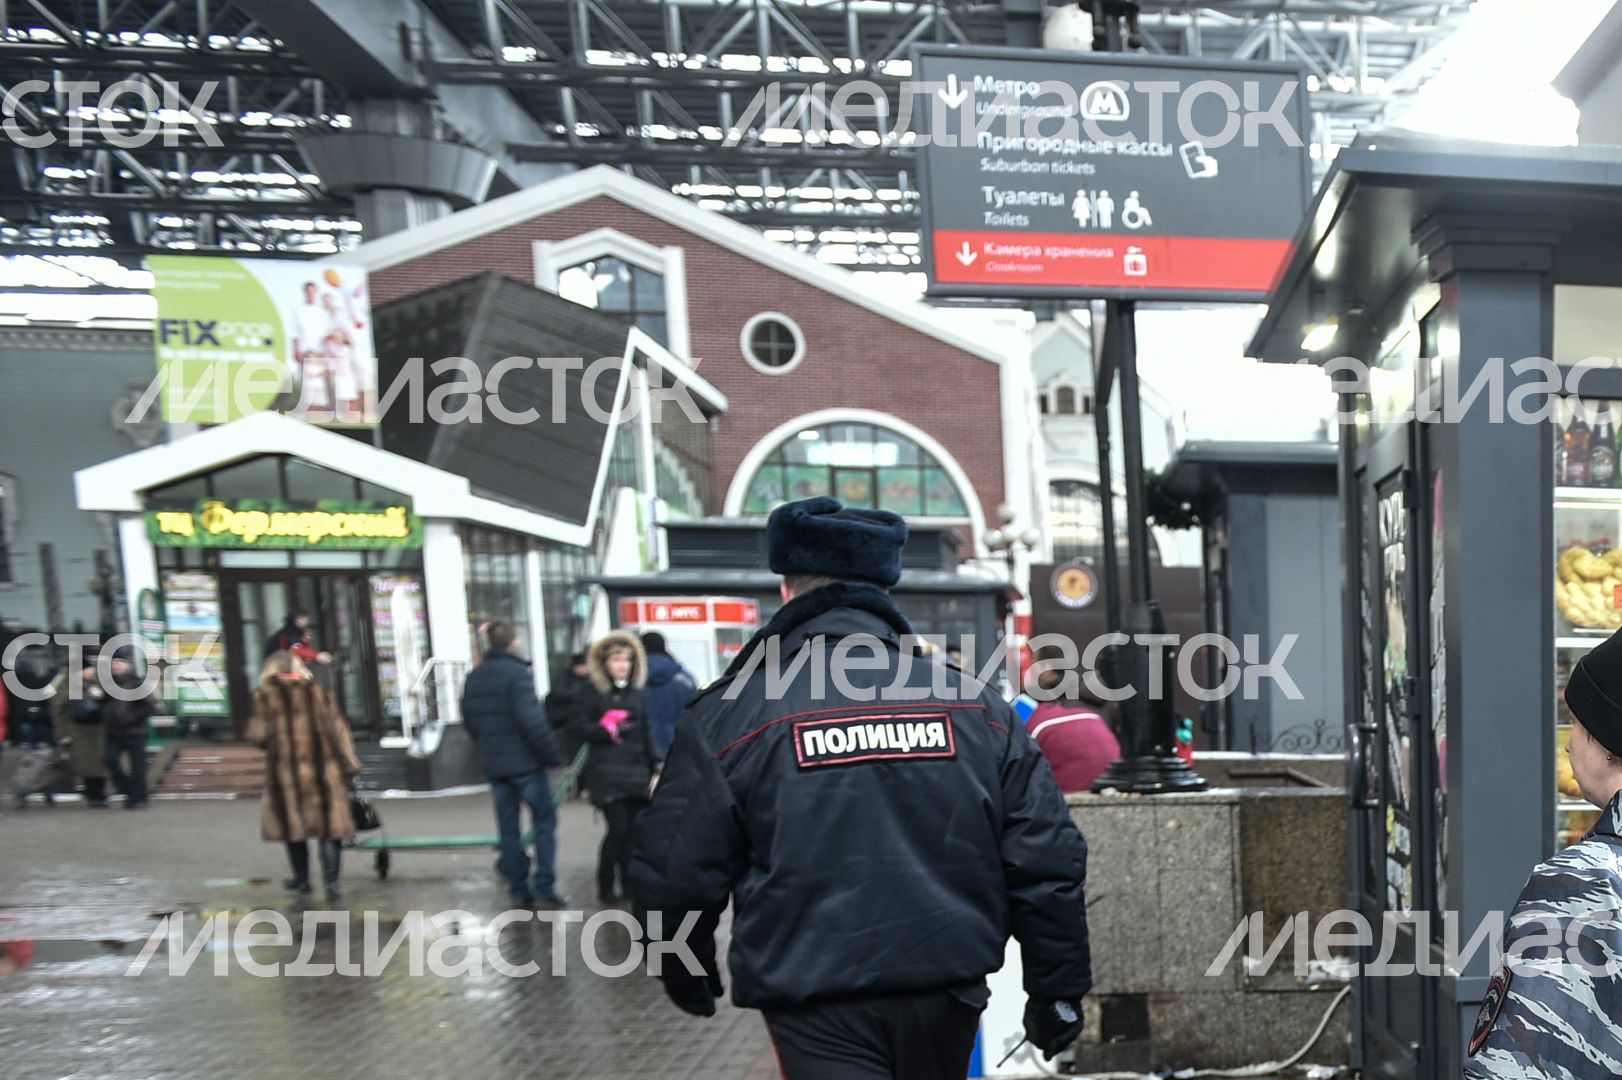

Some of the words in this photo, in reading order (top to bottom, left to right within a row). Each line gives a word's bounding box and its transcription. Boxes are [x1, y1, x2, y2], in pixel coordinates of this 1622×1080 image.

[974, 75, 1041, 97] Метро
[978, 131, 1113, 156] Пригородные
[1117, 141, 1173, 157] кассы
[1051, 160, 1096, 176] tickets
[982, 186, 1065, 207] Туалеты
[983, 211, 1029, 227] Toilets
[984, 242, 1042, 259] Камера
[1044, 246, 1114, 259] хранения
[803, 722, 946, 757] ПОЛИЦИЯ
